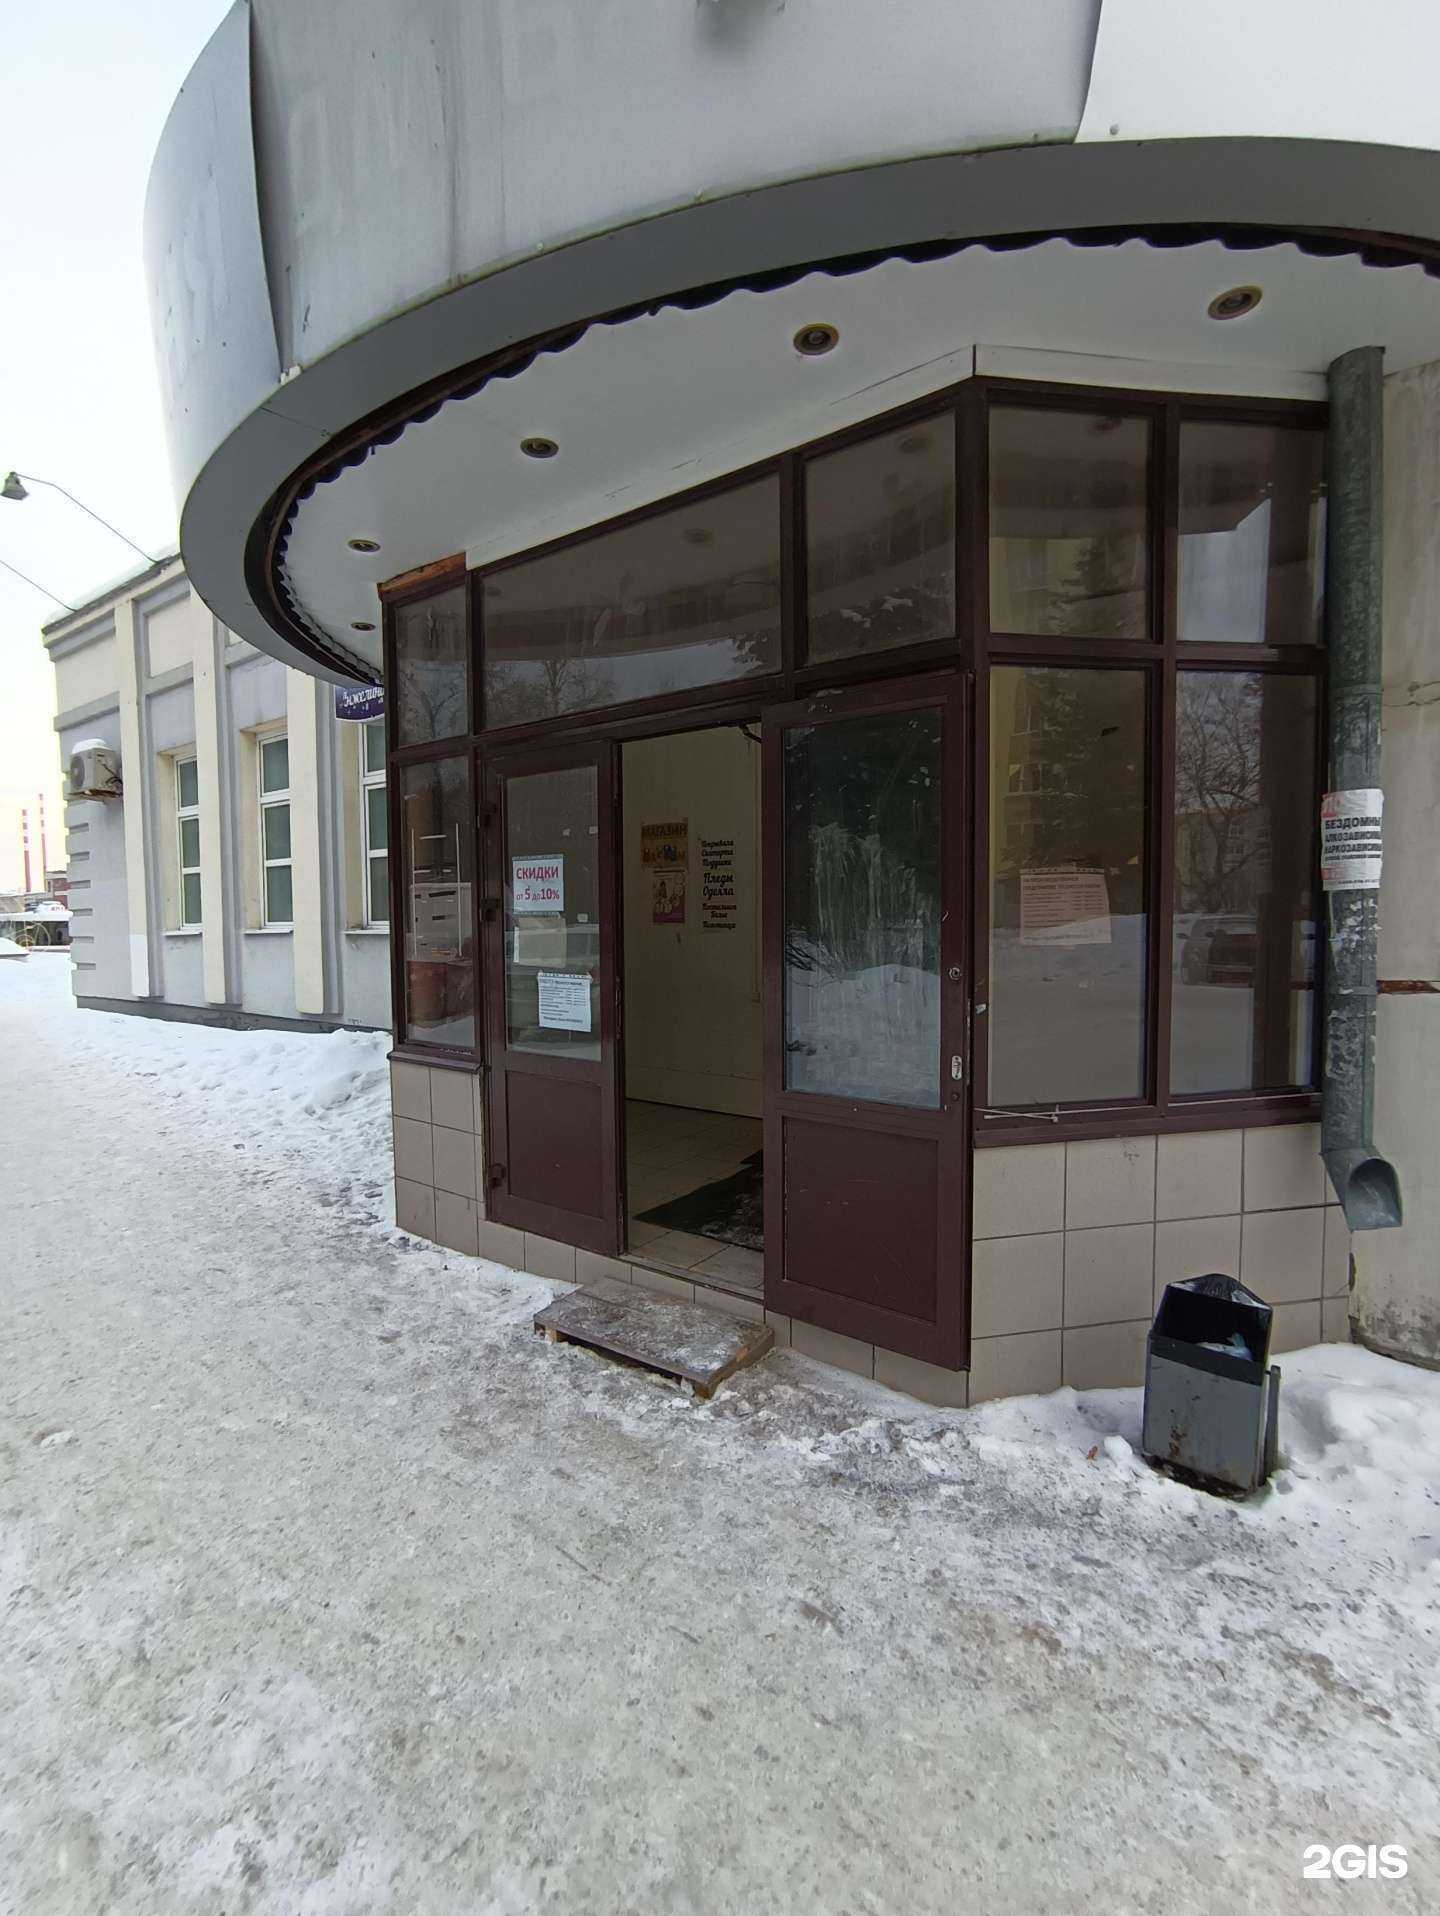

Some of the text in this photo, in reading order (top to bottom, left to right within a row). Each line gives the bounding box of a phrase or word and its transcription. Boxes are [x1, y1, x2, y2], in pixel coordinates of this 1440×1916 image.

[516, 866, 559, 881] СКИДКИ
[704, 872, 734, 887] Пледы
[525, 888, 531, 900] 5
